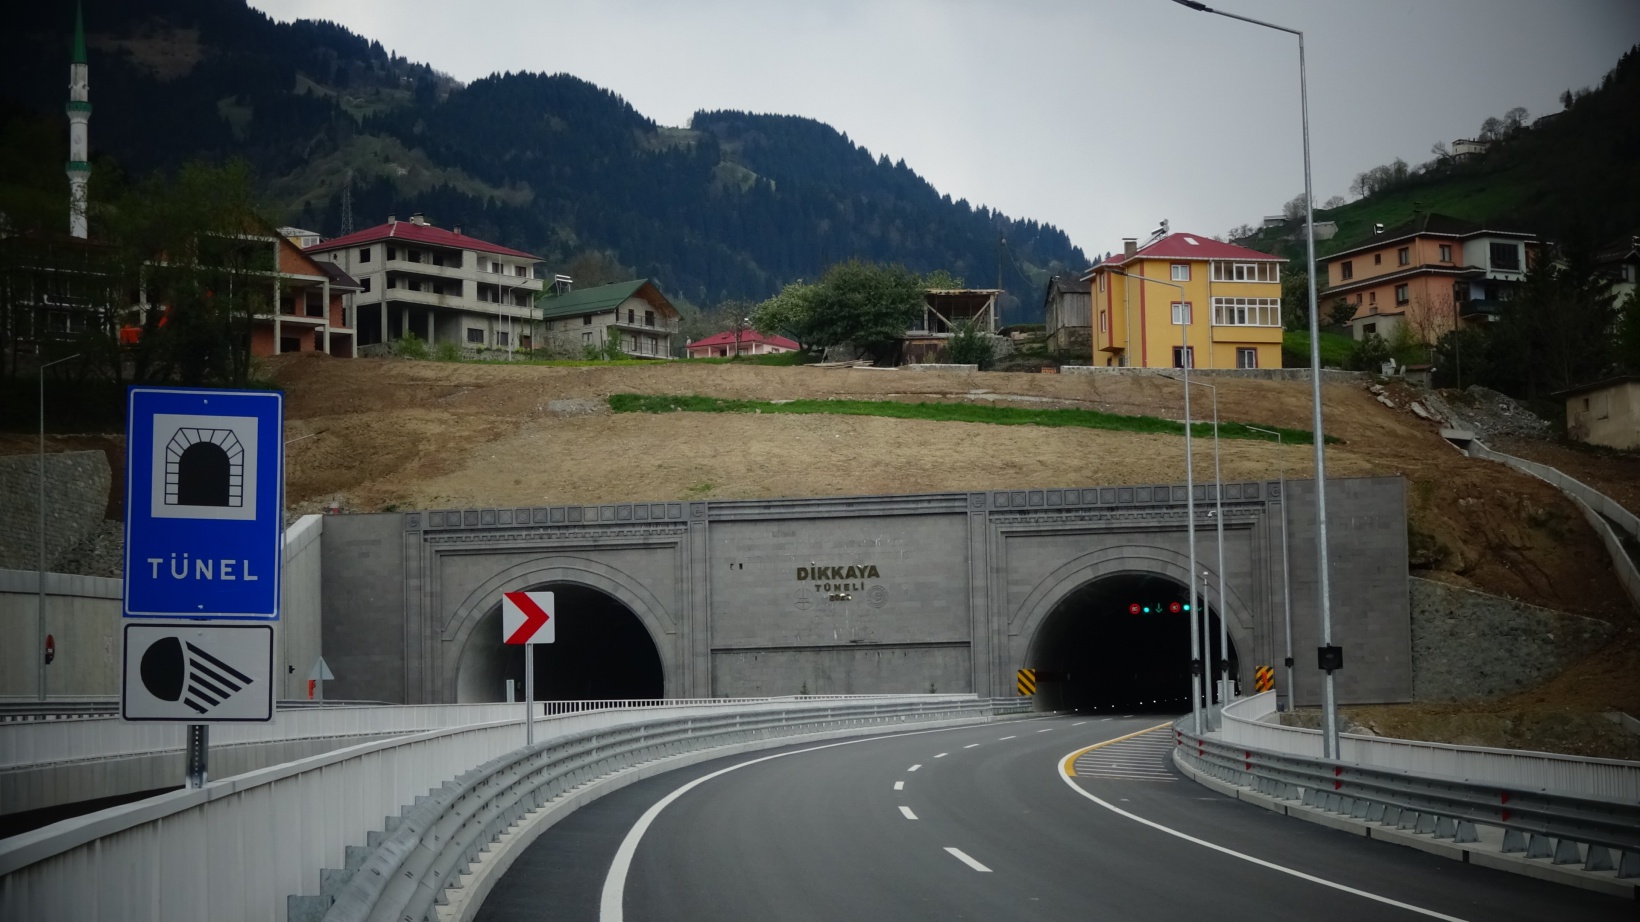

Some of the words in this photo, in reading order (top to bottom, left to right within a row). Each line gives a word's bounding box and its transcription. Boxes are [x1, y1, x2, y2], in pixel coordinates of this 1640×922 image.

[147, 553, 258, 581] TÜNEL
[796, 561, 880, 581] DİKKAYA
[815, 581, 865, 592] TÜNELİ
